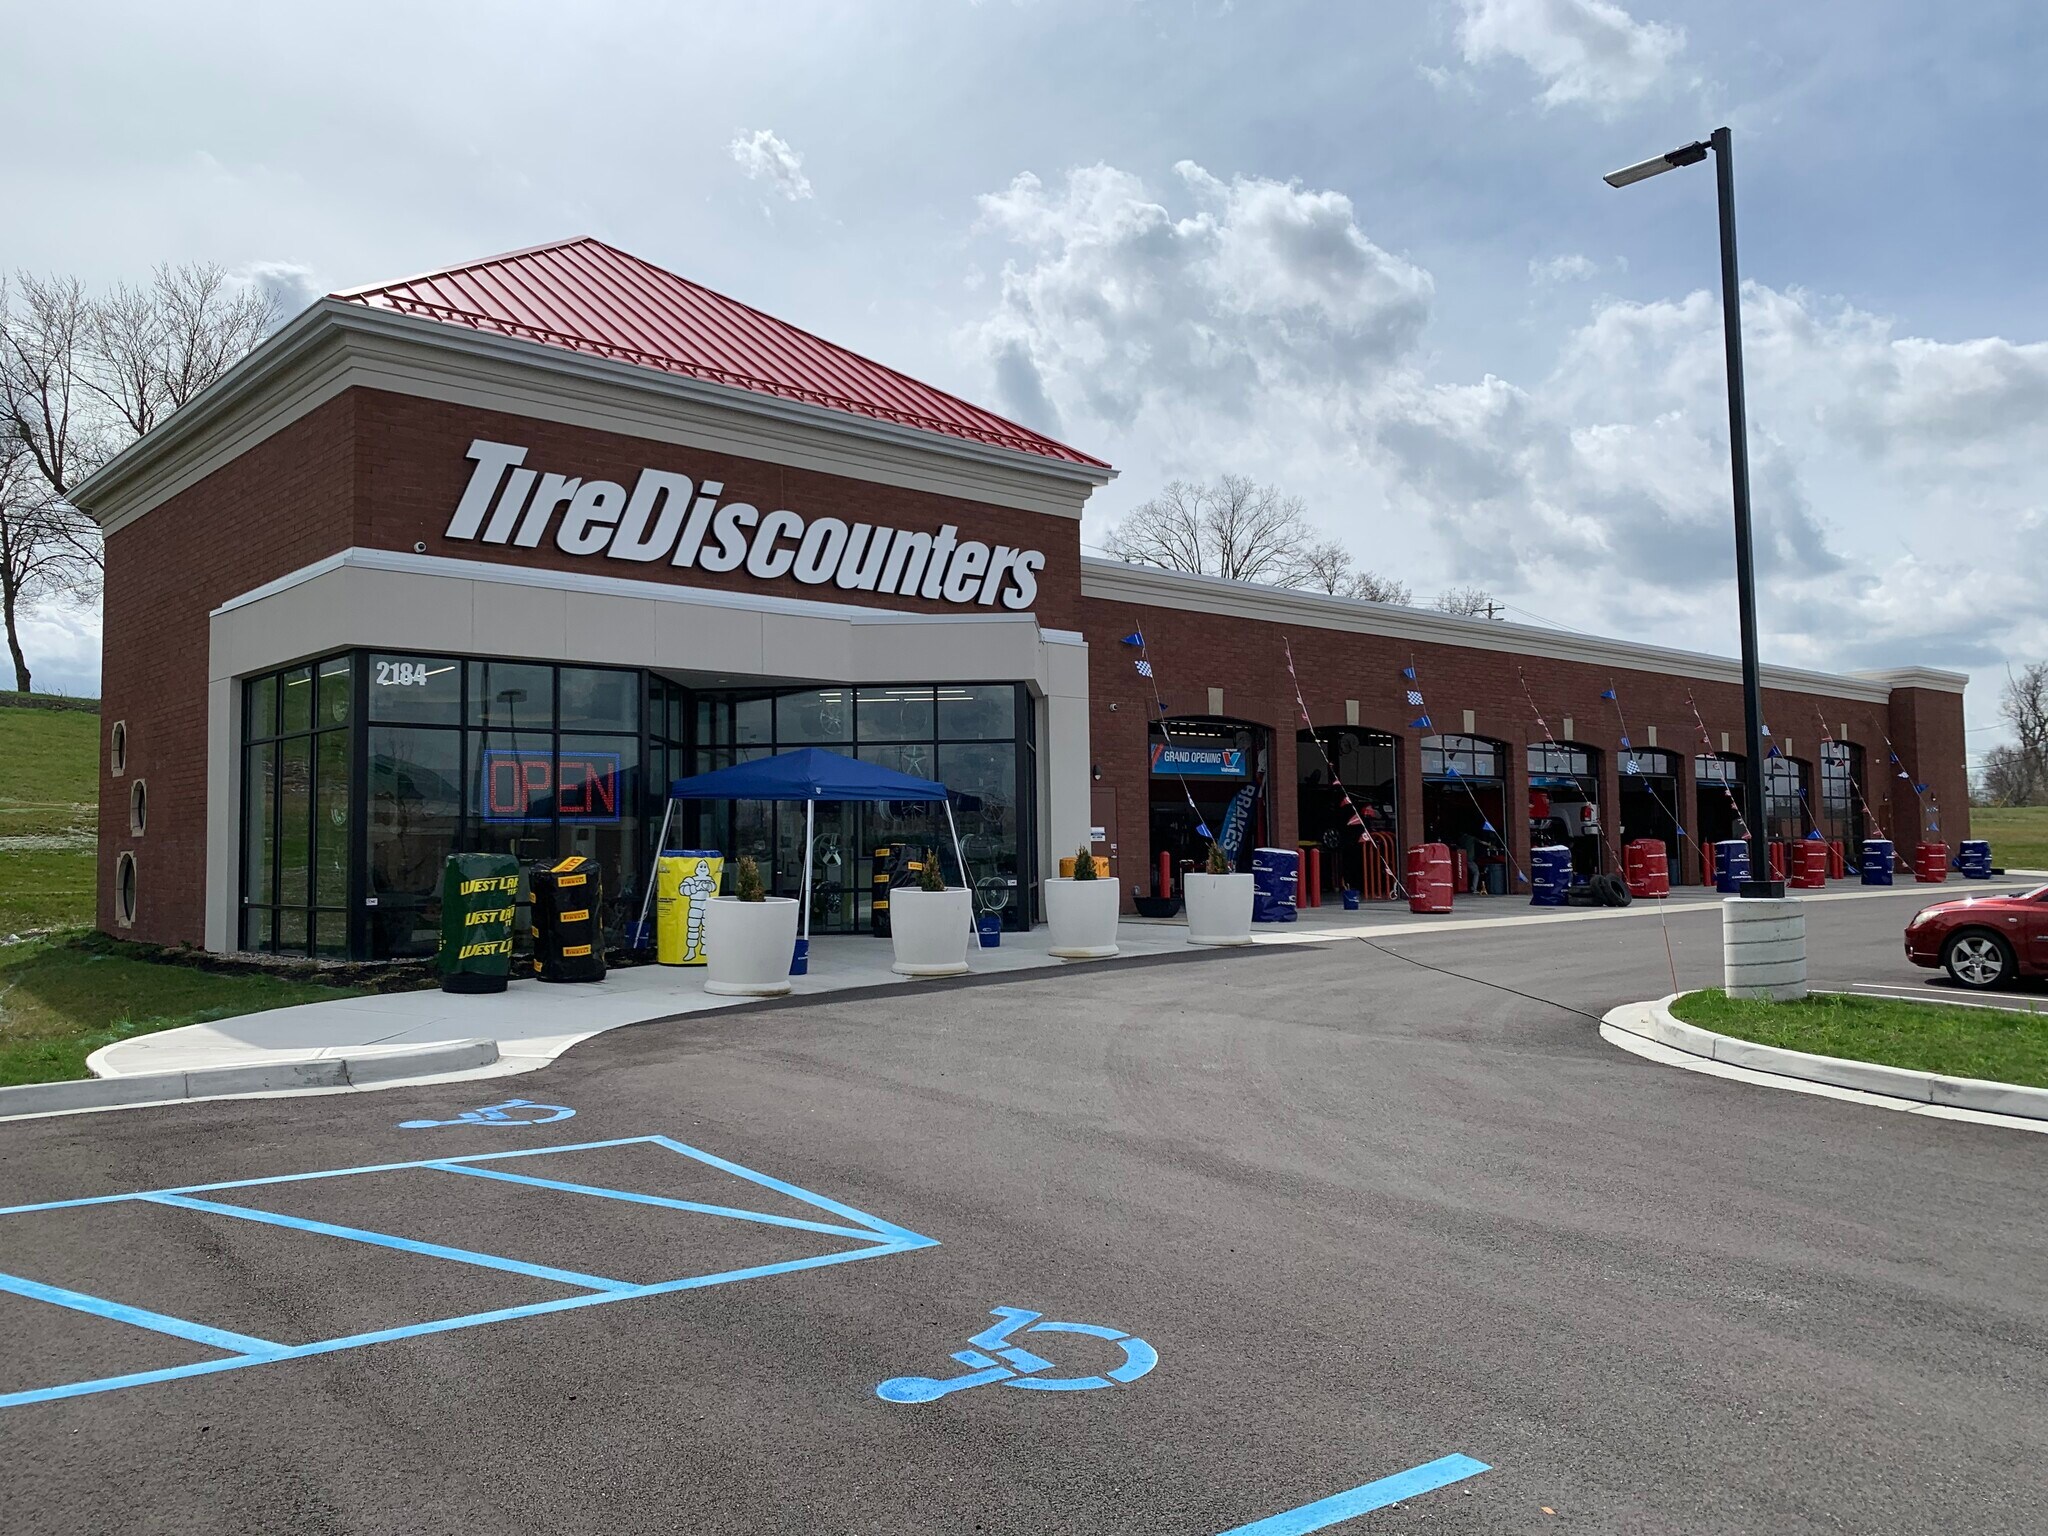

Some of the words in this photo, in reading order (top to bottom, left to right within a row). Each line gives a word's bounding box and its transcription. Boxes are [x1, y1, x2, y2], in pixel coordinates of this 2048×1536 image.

[445, 438, 1046, 610] TireDiscounters
[376, 661, 427, 686] 2184
[1164, 750, 1190, 763] GRAND
[1191, 752, 1221, 764] OPENING
[489, 760, 614, 813] OPEN
[1222, 784, 1256, 852] BRAKES
[460, 878, 498, 896] WEST
[465, 911, 498, 926] WEST
[458, 943, 498, 960] WEST
